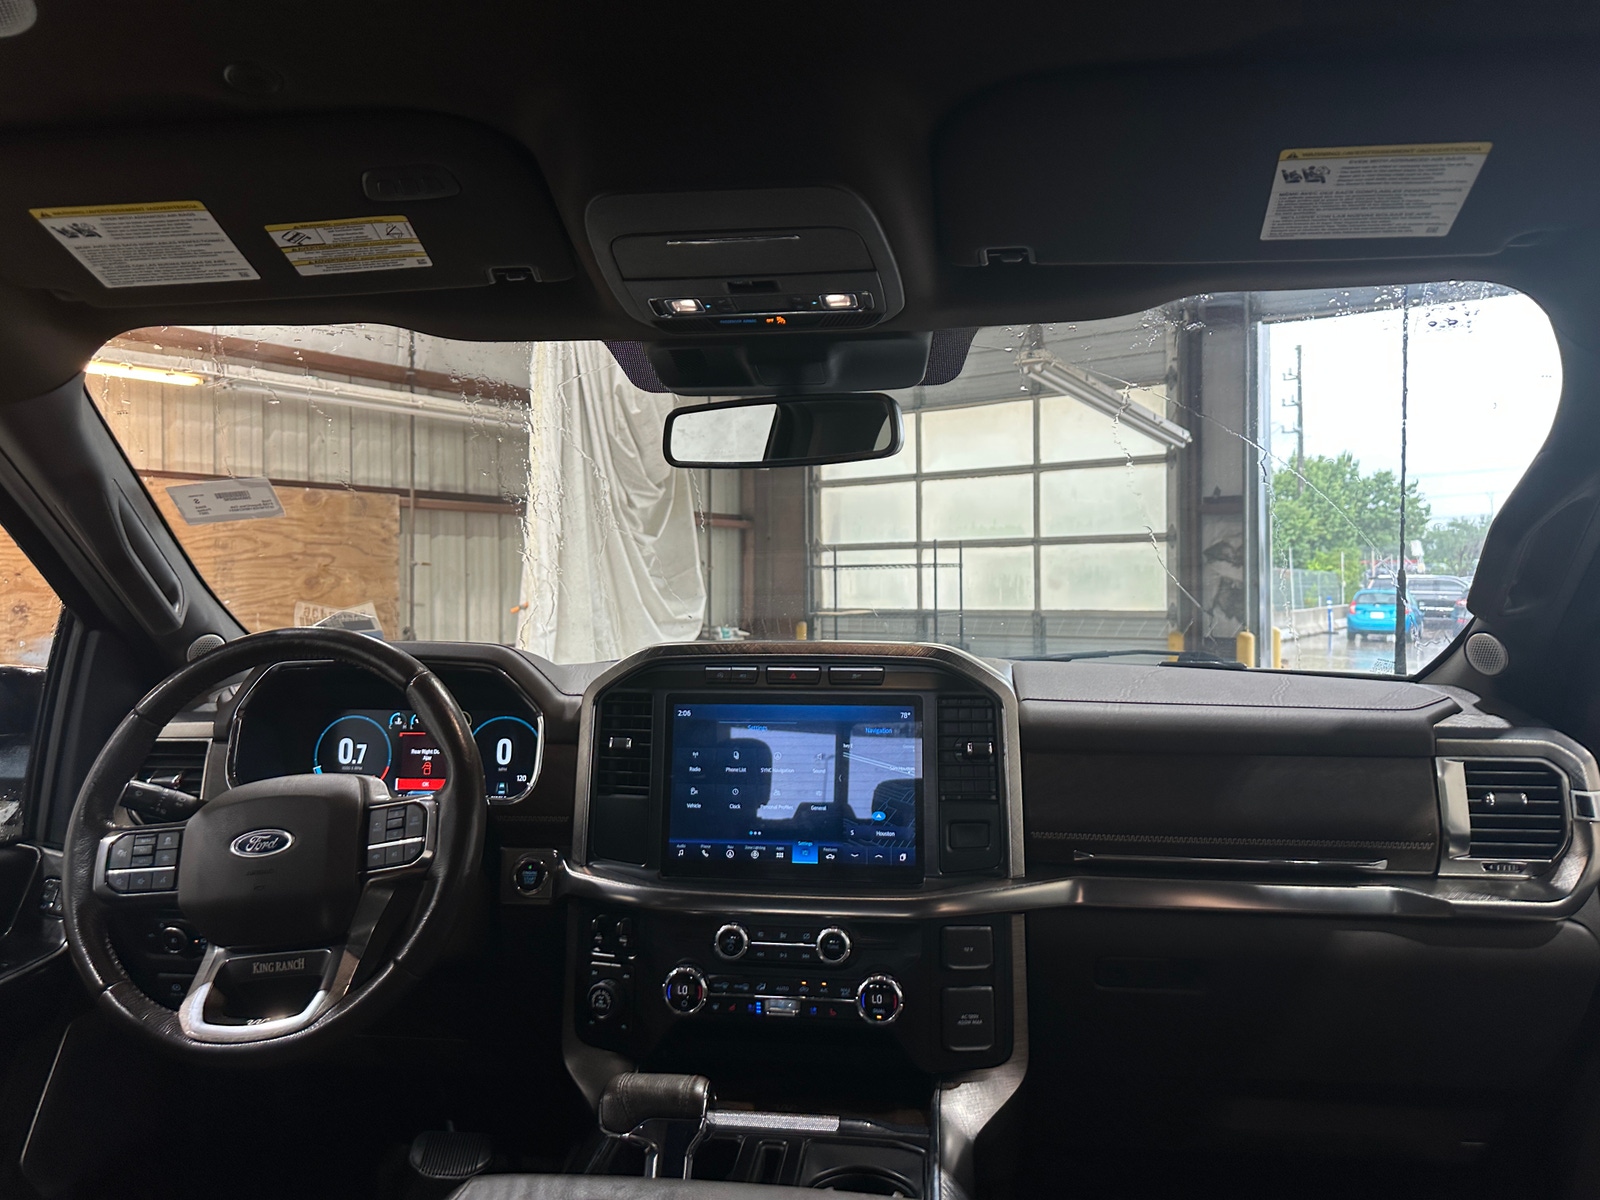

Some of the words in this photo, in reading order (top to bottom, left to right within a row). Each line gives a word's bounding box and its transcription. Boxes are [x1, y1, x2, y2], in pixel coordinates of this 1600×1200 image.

[338, 737, 368, 764] 0.7
[496, 737, 512, 765] 0
[253, 961, 274, 974] KING
[276, 958, 305, 971] RANCH
[677, 985, 688, 996] LO
[871, 994, 883, 1004] LO
